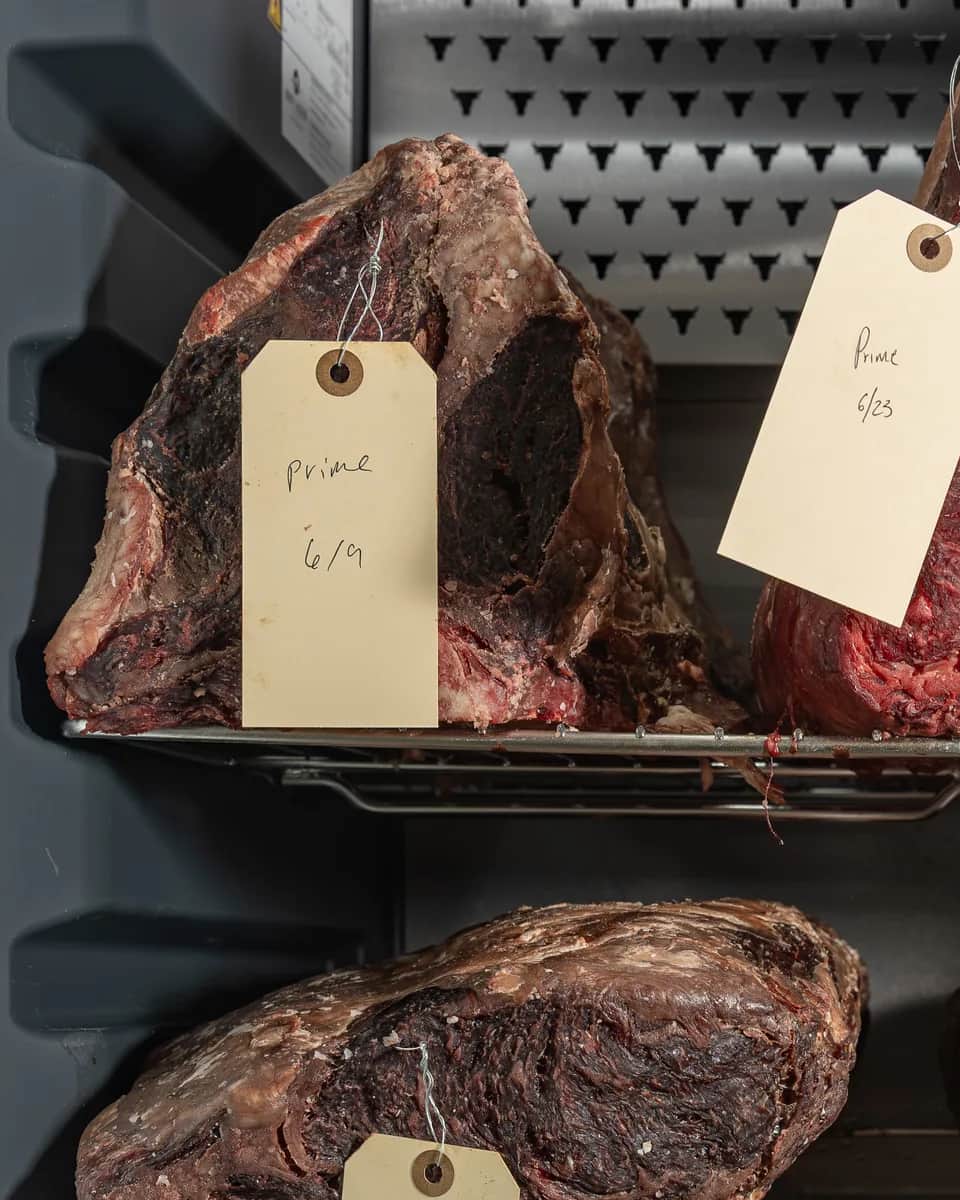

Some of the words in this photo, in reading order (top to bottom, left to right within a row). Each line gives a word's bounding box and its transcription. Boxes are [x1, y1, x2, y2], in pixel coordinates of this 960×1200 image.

[853, 325, 899, 370] Prime
[857, 386, 893, 424] 6/23
[304, 537, 362, 572] 6/9
